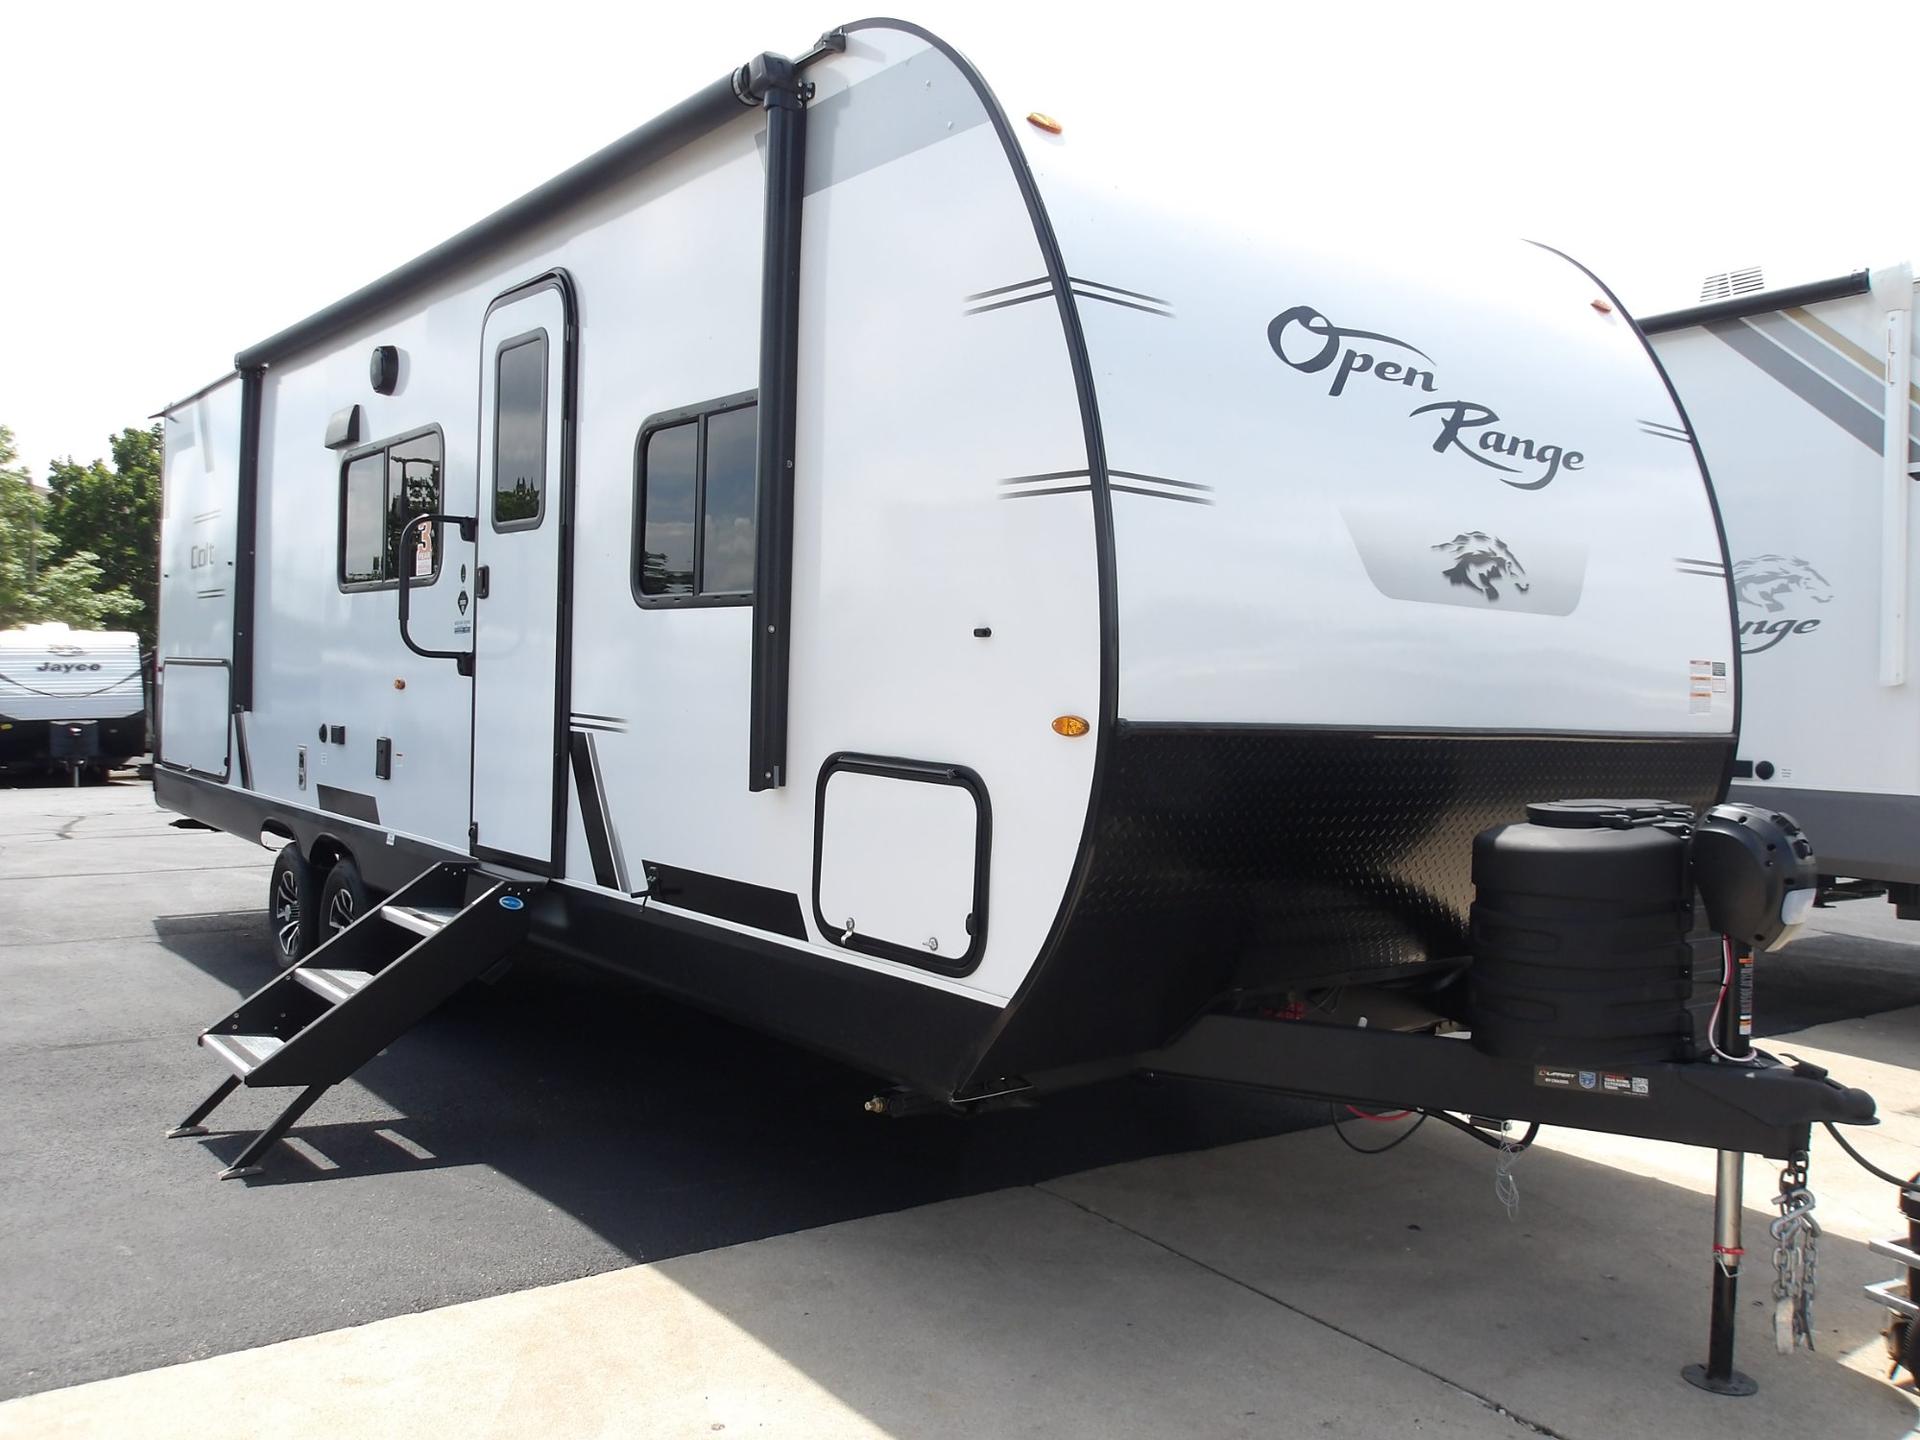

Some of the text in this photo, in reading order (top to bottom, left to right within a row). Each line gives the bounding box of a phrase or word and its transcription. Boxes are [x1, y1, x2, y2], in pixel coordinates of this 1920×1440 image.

[1267, 305, 1438, 397] Open
[1409, 400, 1584, 490] Range
[191, 542, 214, 569] Colt
[1740, 619, 1821, 654] nge
[36, 662, 101, 675] Jayco
